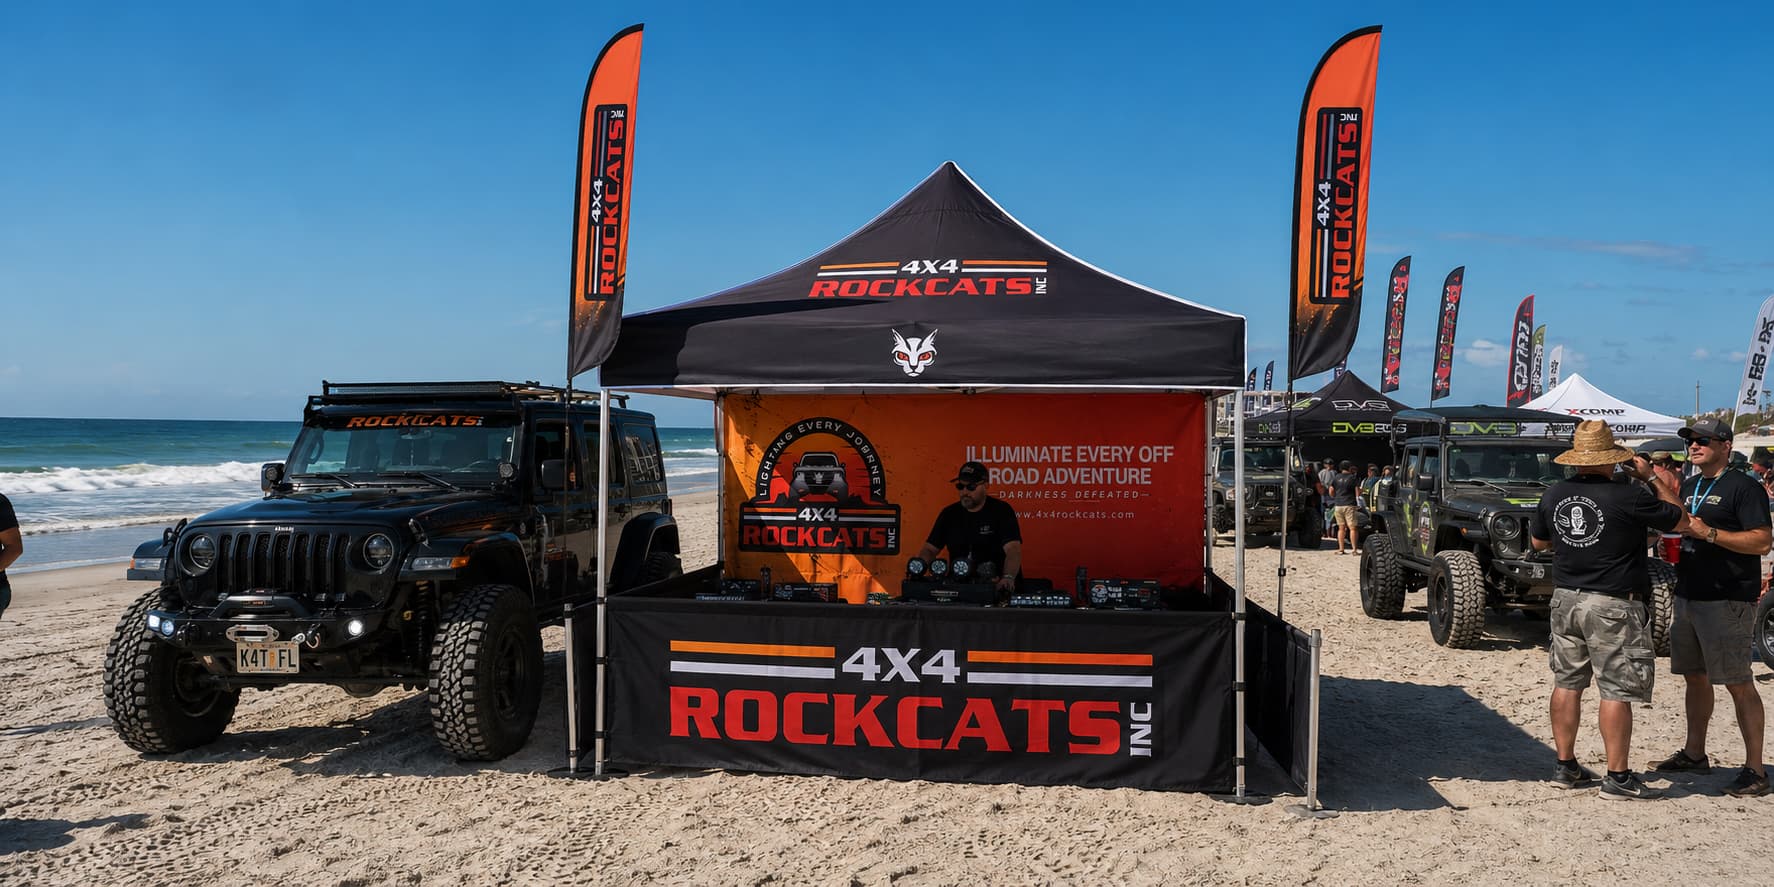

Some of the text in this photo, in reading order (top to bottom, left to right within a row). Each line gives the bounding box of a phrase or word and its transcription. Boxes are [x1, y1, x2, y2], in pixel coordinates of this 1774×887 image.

[591, 178, 603, 223] 4X4
[600, 119, 624, 294] ROCKCATS
[1317, 182, 1331, 226] 4X4
[1331, 123, 1357, 298] ROCKCATS
[901, 259, 958, 274] 4X4
[808, 277, 1047, 297] ROCKCATS INC
[797, 421, 842, 434] EVERY
[966, 445, 1174, 463] ILLUMINATE EVERY OFF
[988, 467, 1152, 485] ROAD ADVENTURE
[1000, 490, 1139, 499] DARKNESS DEFEATED
[798, 507, 837, 522] 4X4
[1014, 509, 1135, 519] ww.4x4rockcats.com
[743, 525, 896, 549] ROCKCATS INC
[240, 649, 297, 667] K4T FL
[842, 646, 961, 684] 4X4
[669, 686, 1153, 758] ROCKCATS INC
